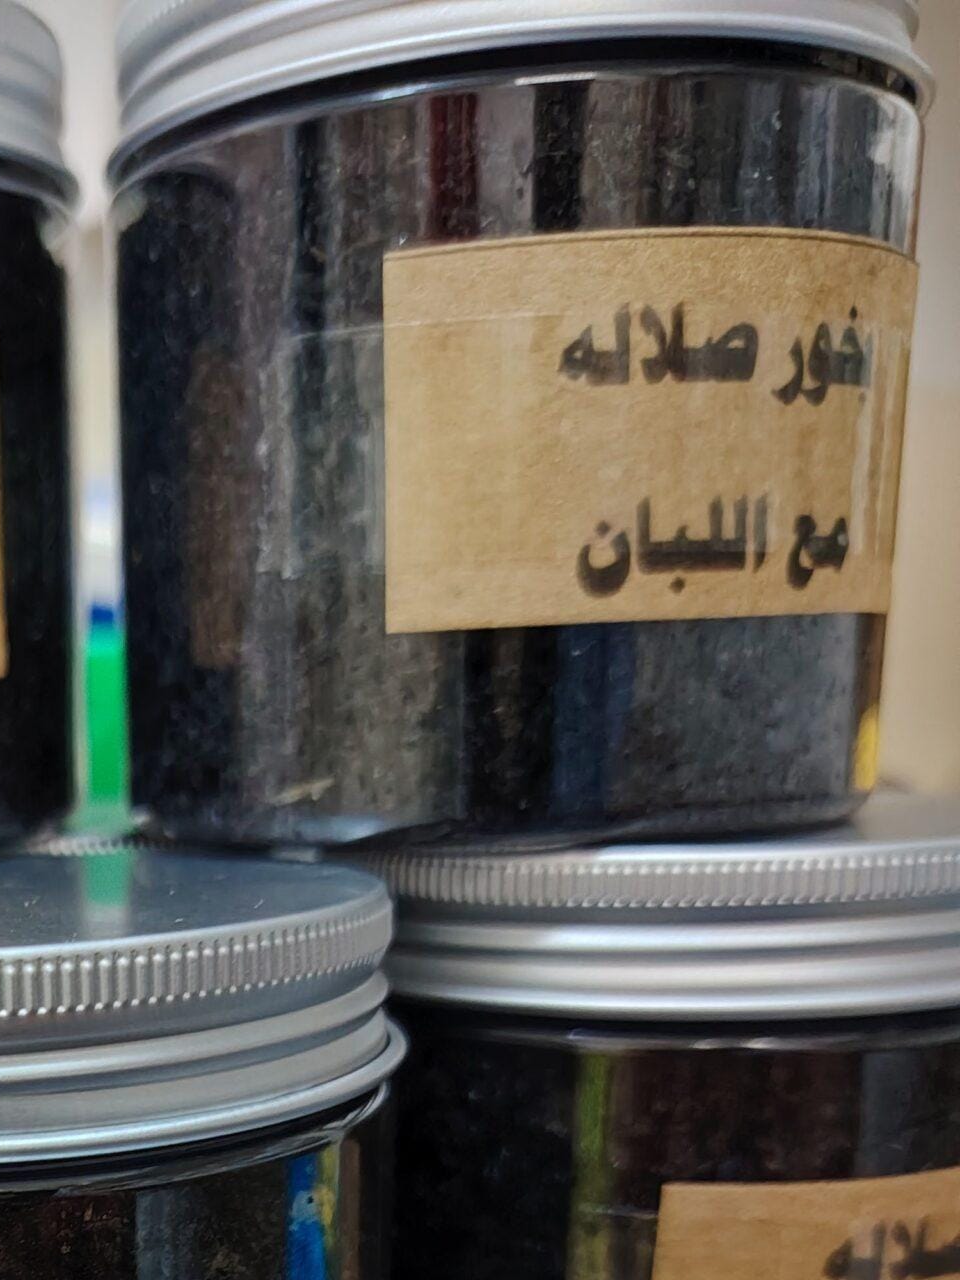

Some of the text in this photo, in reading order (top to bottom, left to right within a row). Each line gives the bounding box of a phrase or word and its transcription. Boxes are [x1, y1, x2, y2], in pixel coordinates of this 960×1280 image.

[557, 300, 759, 386] صلاله
[576, 493, 849, 598] مع اللبان
